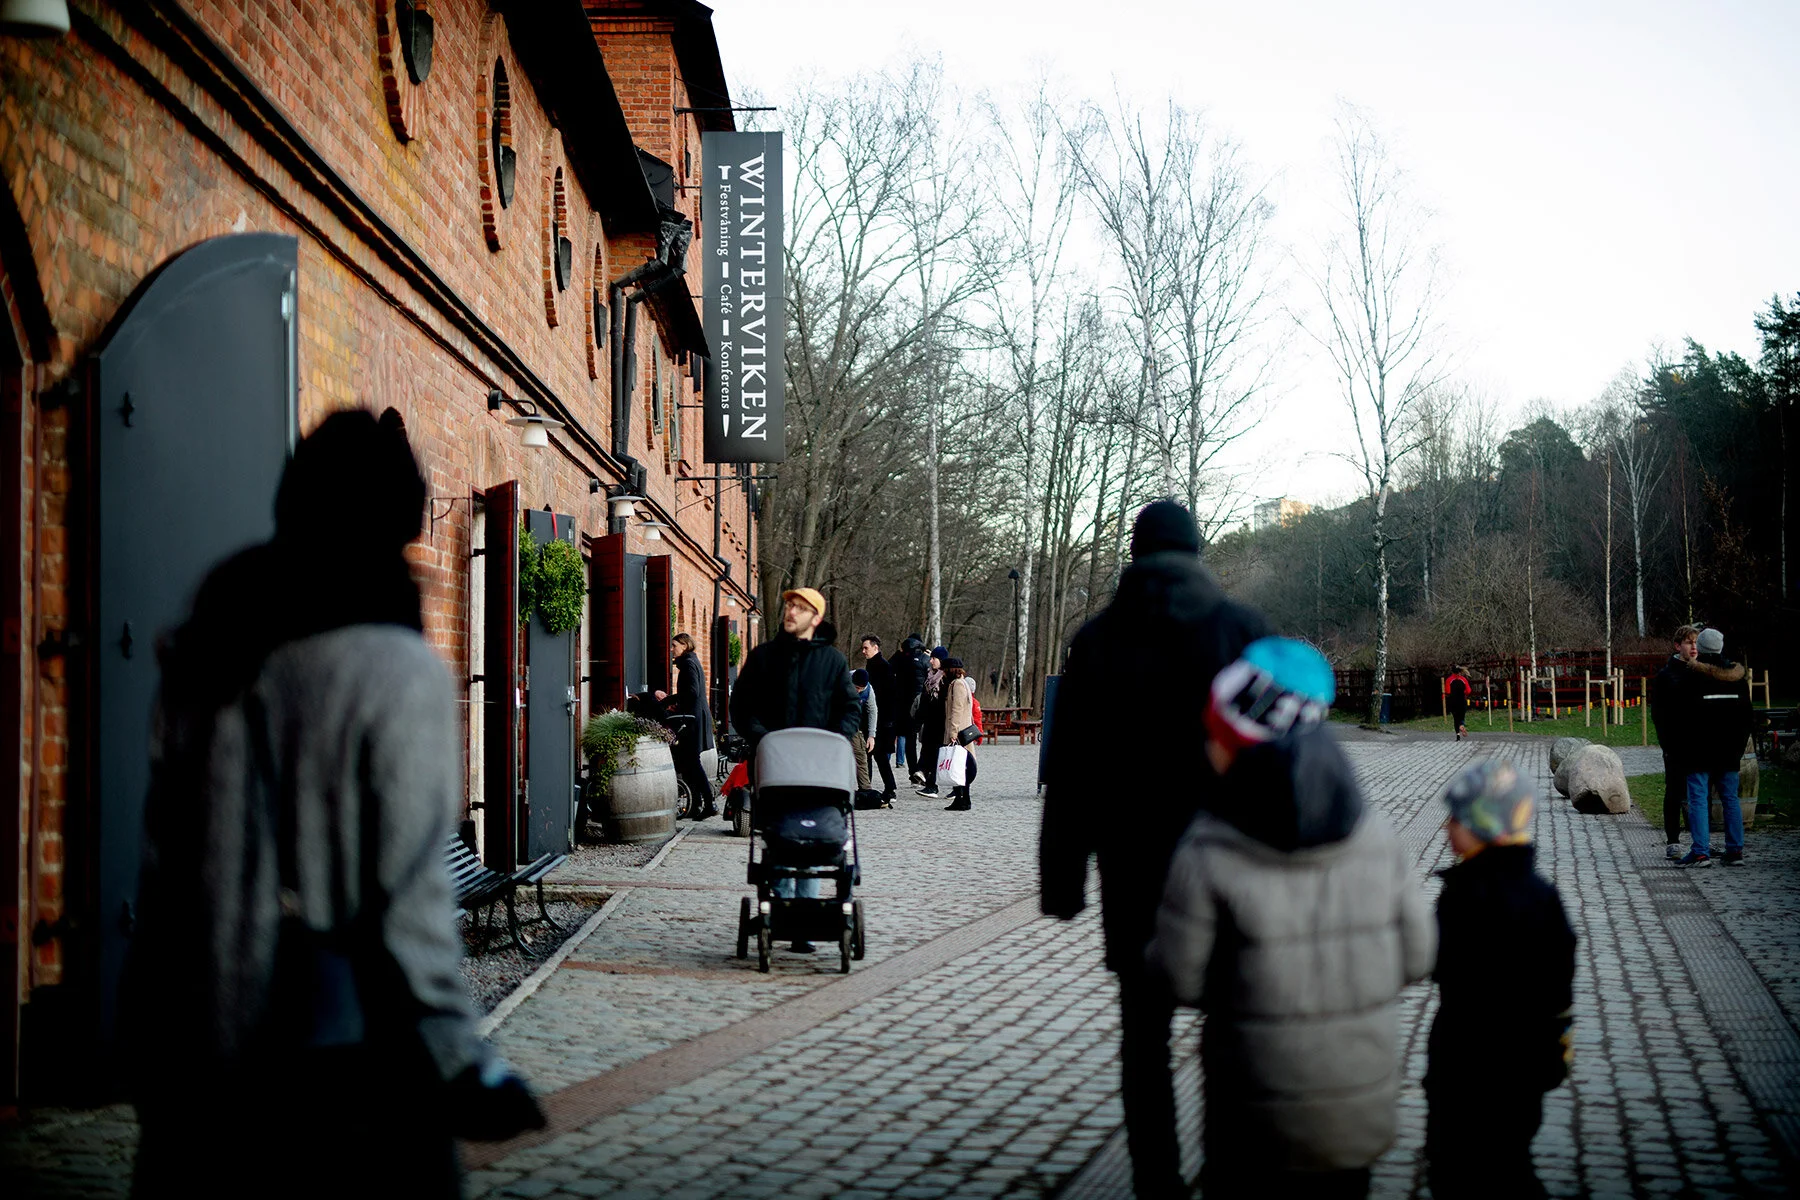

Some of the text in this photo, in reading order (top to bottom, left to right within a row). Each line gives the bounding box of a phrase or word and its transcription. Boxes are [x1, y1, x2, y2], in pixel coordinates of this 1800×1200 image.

[716, 184, 733, 409] Festvåning Café Konferens
[739, 152, 767, 441] WINTERVIKEN
